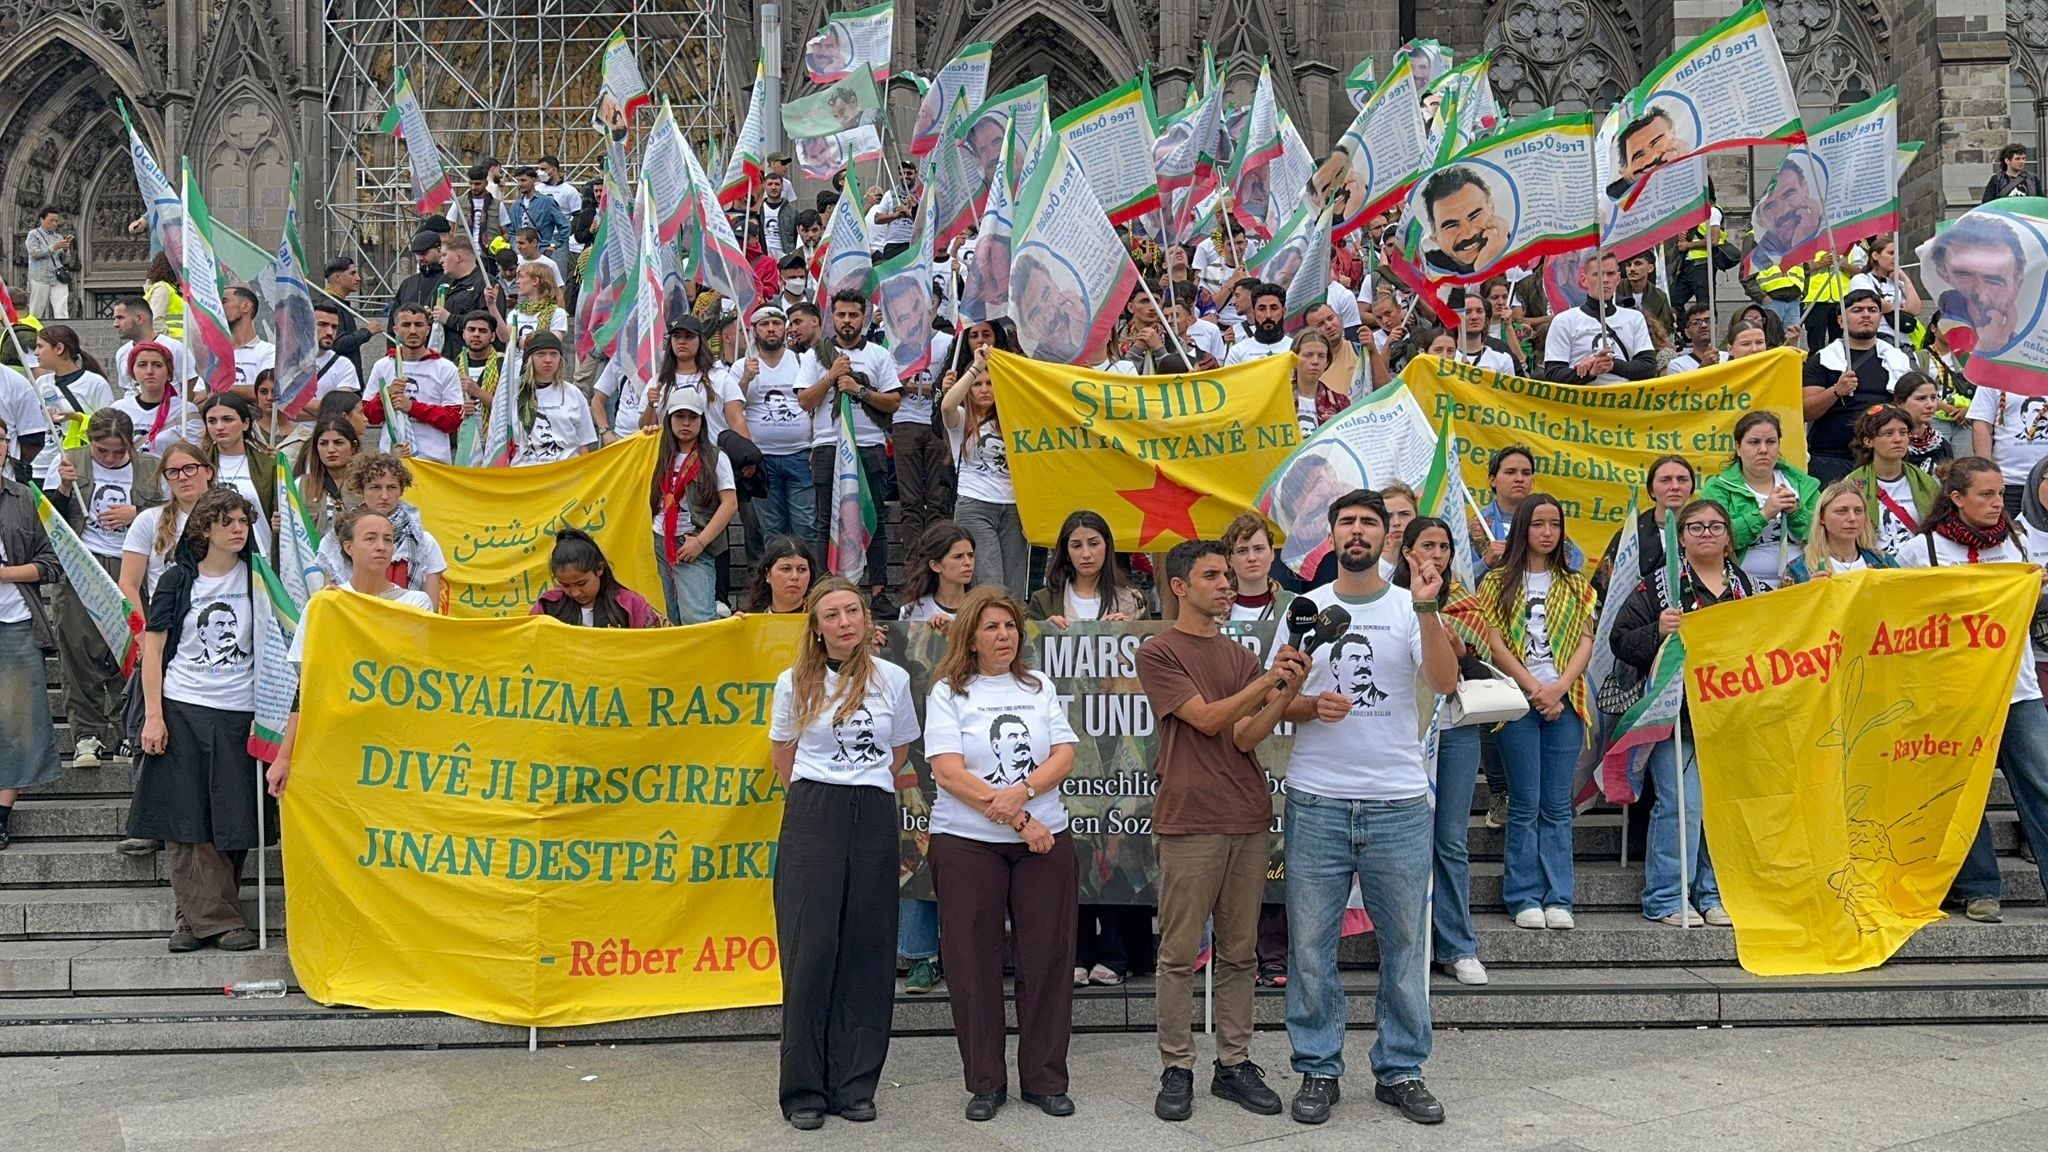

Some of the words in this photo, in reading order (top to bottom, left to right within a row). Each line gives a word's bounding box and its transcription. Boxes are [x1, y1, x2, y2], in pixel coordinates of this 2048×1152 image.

[1071, 375, 1227, 427] ŞEHÎD
[1489, 367, 1752, 412] kommunalistische
[1137, 420, 1248, 461] JIYANÊ
[1256, 423, 1297, 450] NE
[1433, 393, 1637, 450] Persönlichkeit
[1646, 425, 1683, 451] ist
[1868, 612, 1953, 656] Azadî
[1960, 614, 2007, 650] Yo
[349, 660, 632, 728] SOSYALÎZMA
[648, 682, 774, 727] RAST
[1694, 654, 1765, 703] Ked
[1085, 694, 1155, 737] UND
[356, 742, 473, 797] DIVÊ
[480, 758, 517, 801] JI
[1107, 809, 1155, 835] Soz
[358, 826, 497, 877] JINAN
[506, 829, 678, 882] DESTPÊ
[568, 938, 684, 977] Rêber
[692, 935, 777, 973] APO
